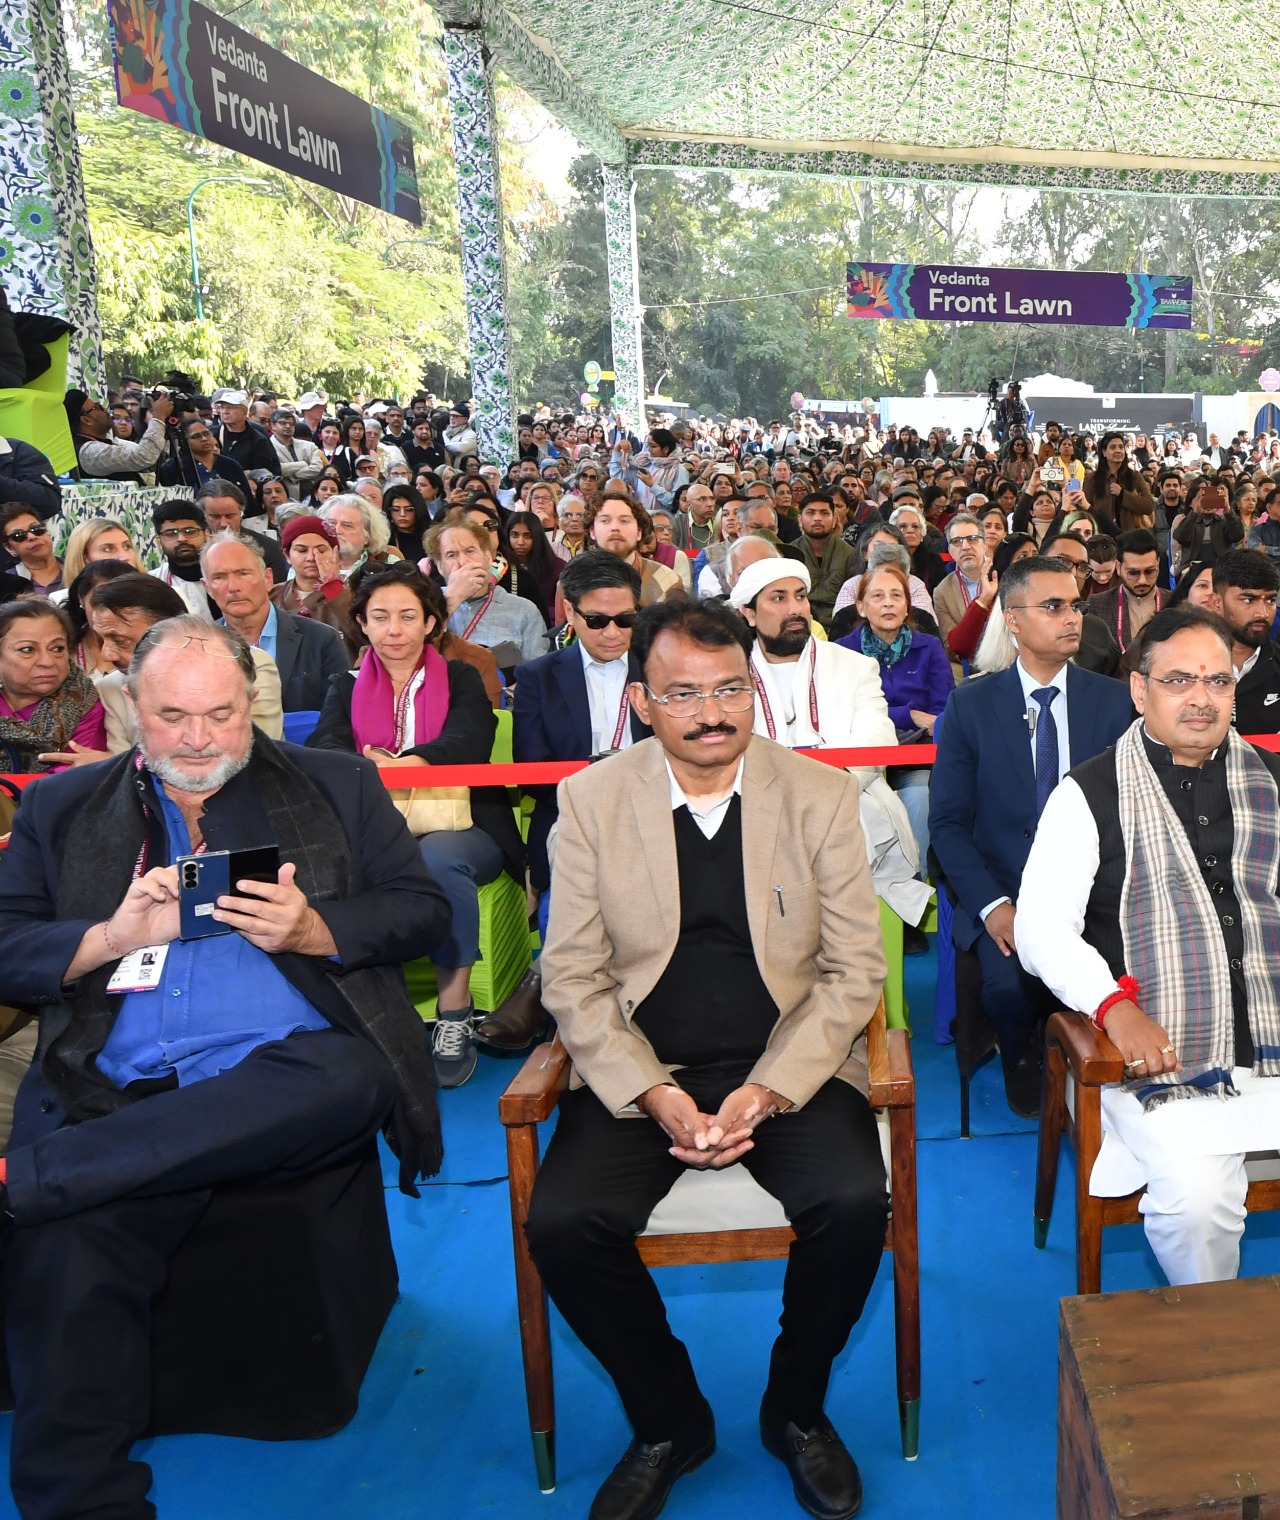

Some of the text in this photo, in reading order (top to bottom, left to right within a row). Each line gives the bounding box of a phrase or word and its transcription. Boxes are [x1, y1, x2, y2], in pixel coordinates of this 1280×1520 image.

[205, 21, 268, 83] Vedanta
[211, 66, 342, 175] Front Lawn
[928, 270, 990, 286] Vedanta
[929, 288, 1072, 317] Front Lawn
[1079, 423, 1105, 432] LAND
